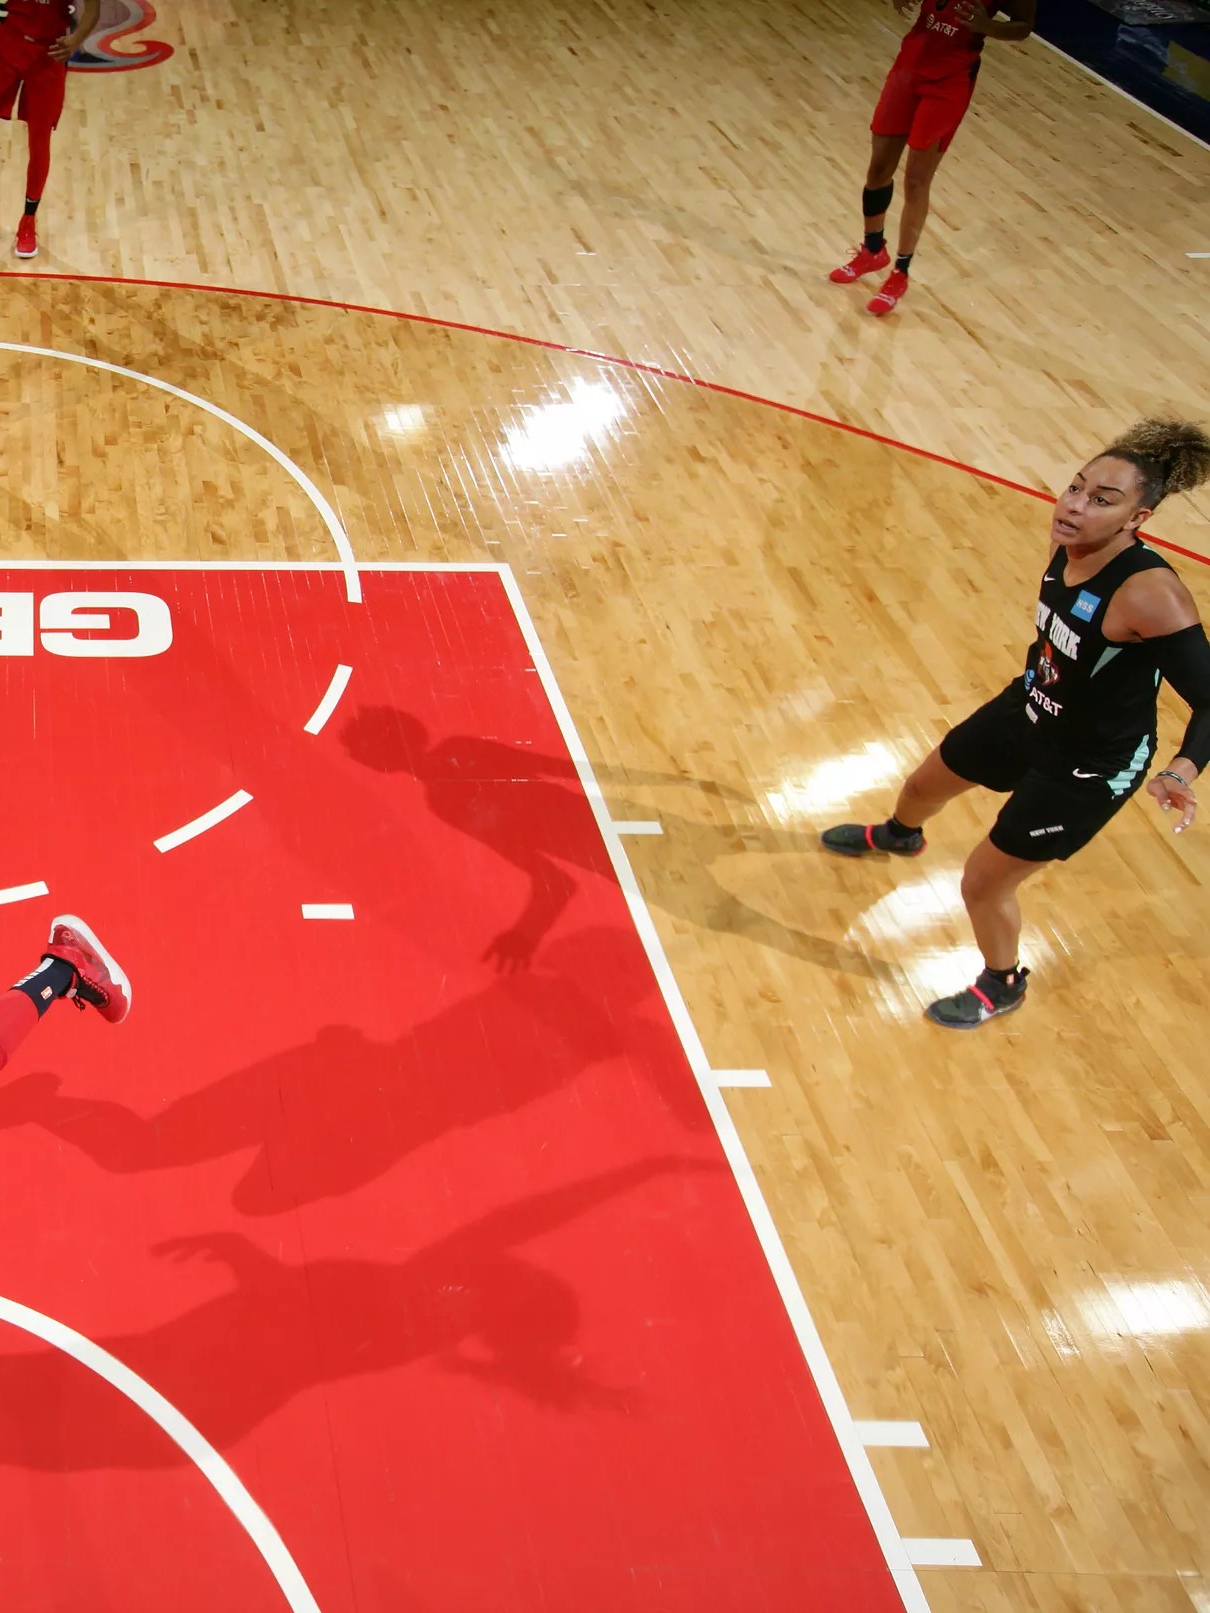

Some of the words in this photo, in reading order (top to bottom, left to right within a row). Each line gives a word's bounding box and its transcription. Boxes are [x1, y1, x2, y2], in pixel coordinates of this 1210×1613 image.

[931, 22, 959, 37] AT&T
[1076, 599, 1094, 613] HSS
[1048, 612, 1081, 661] YORK
[1029, 686, 1063, 717] AT&T
